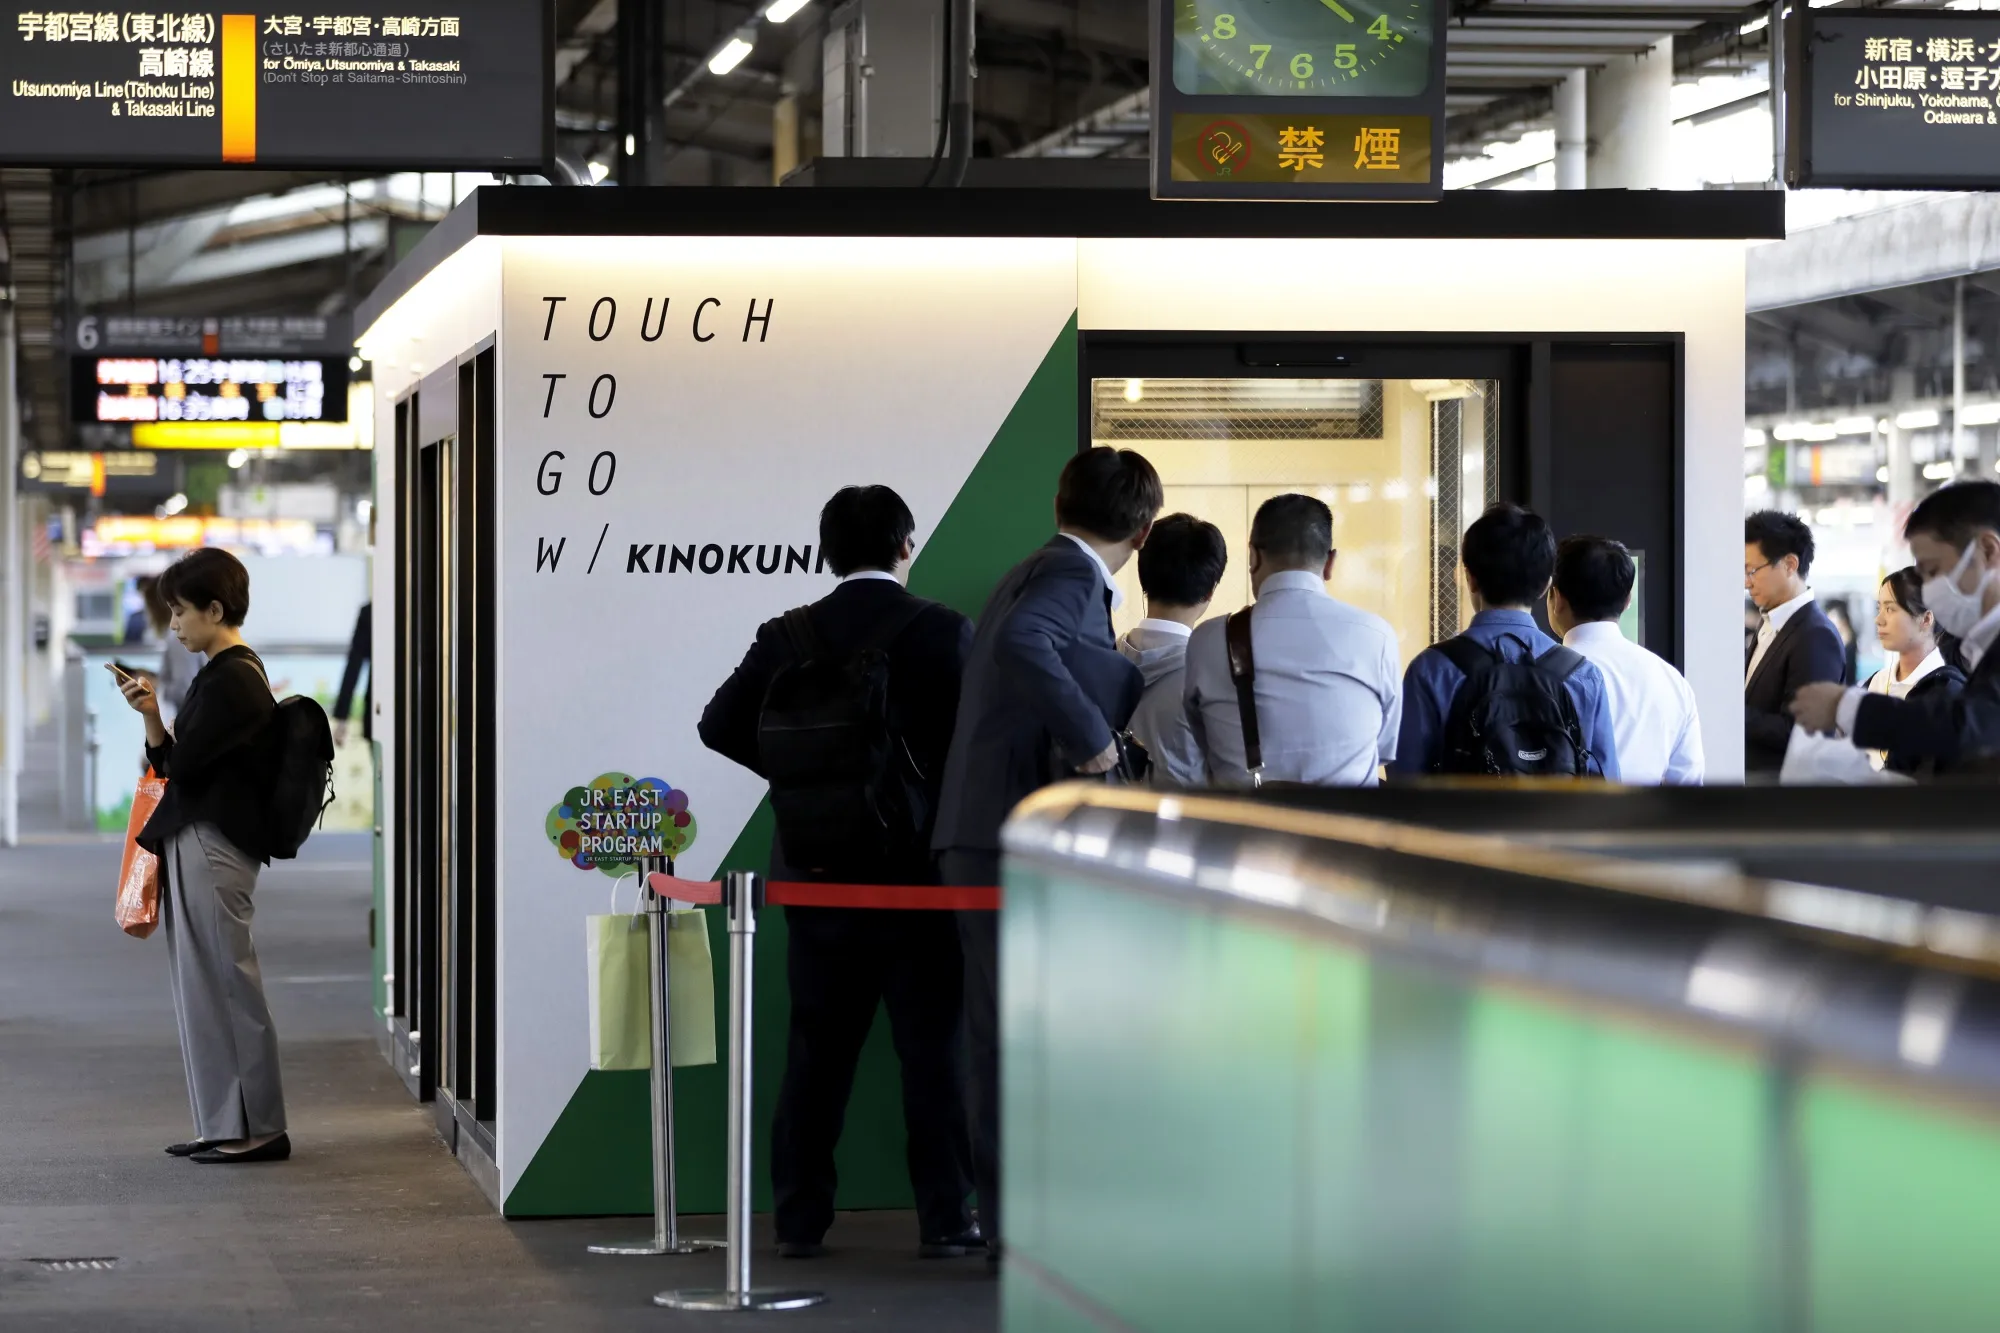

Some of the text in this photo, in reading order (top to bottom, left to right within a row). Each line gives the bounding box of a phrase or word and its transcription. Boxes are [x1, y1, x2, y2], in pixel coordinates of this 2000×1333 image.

[18, 12, 215, 43] 宇都宮線（東北線）
[263, 15, 460, 37] 大宮・宇都宮・高崎方面
[1212, 14, 1237, 40] 8
[1366, 14, 1392, 40] 4
[138, 47, 215, 78] 高崎線
[263, 58, 281, 70] for
[398, 60, 406, 71] &
[408, 60, 460, 72] Takasaki
[1249, 44, 1272, 70] 7
[1289, 53, 1314, 79] 6
[1333, 44, 1358, 69] 5
[12, 80, 91, 100] Utsunomiya
[181, 82, 215, 100] Line)
[263, 73, 297, 84] (Don't
[301, 73, 328, 86] Stop
[332, 74, 344, 84] at
[111, 101, 215, 117] & Takasaki Line
[1834, 93, 1852, 106] for
[1855, 93, 1915, 109] Shinjuku,
[1918, 93, 1993, 109] Yokohama,
[1923, 110, 1998, 124] Odawara &
[1278, 127, 1400, 171] 禁煙
[542, 296, 774, 342] TOUCH
[76, 316, 99, 350] 6
[542, 373, 617, 419] TO
[536, 450, 617, 496] GO
[626, 543, 836, 575] KINOKUNI
[580, 789, 663, 807] JR EAST
[581, 812, 662, 830] STARTUP
[581, 836, 663, 853] PROGRAM
